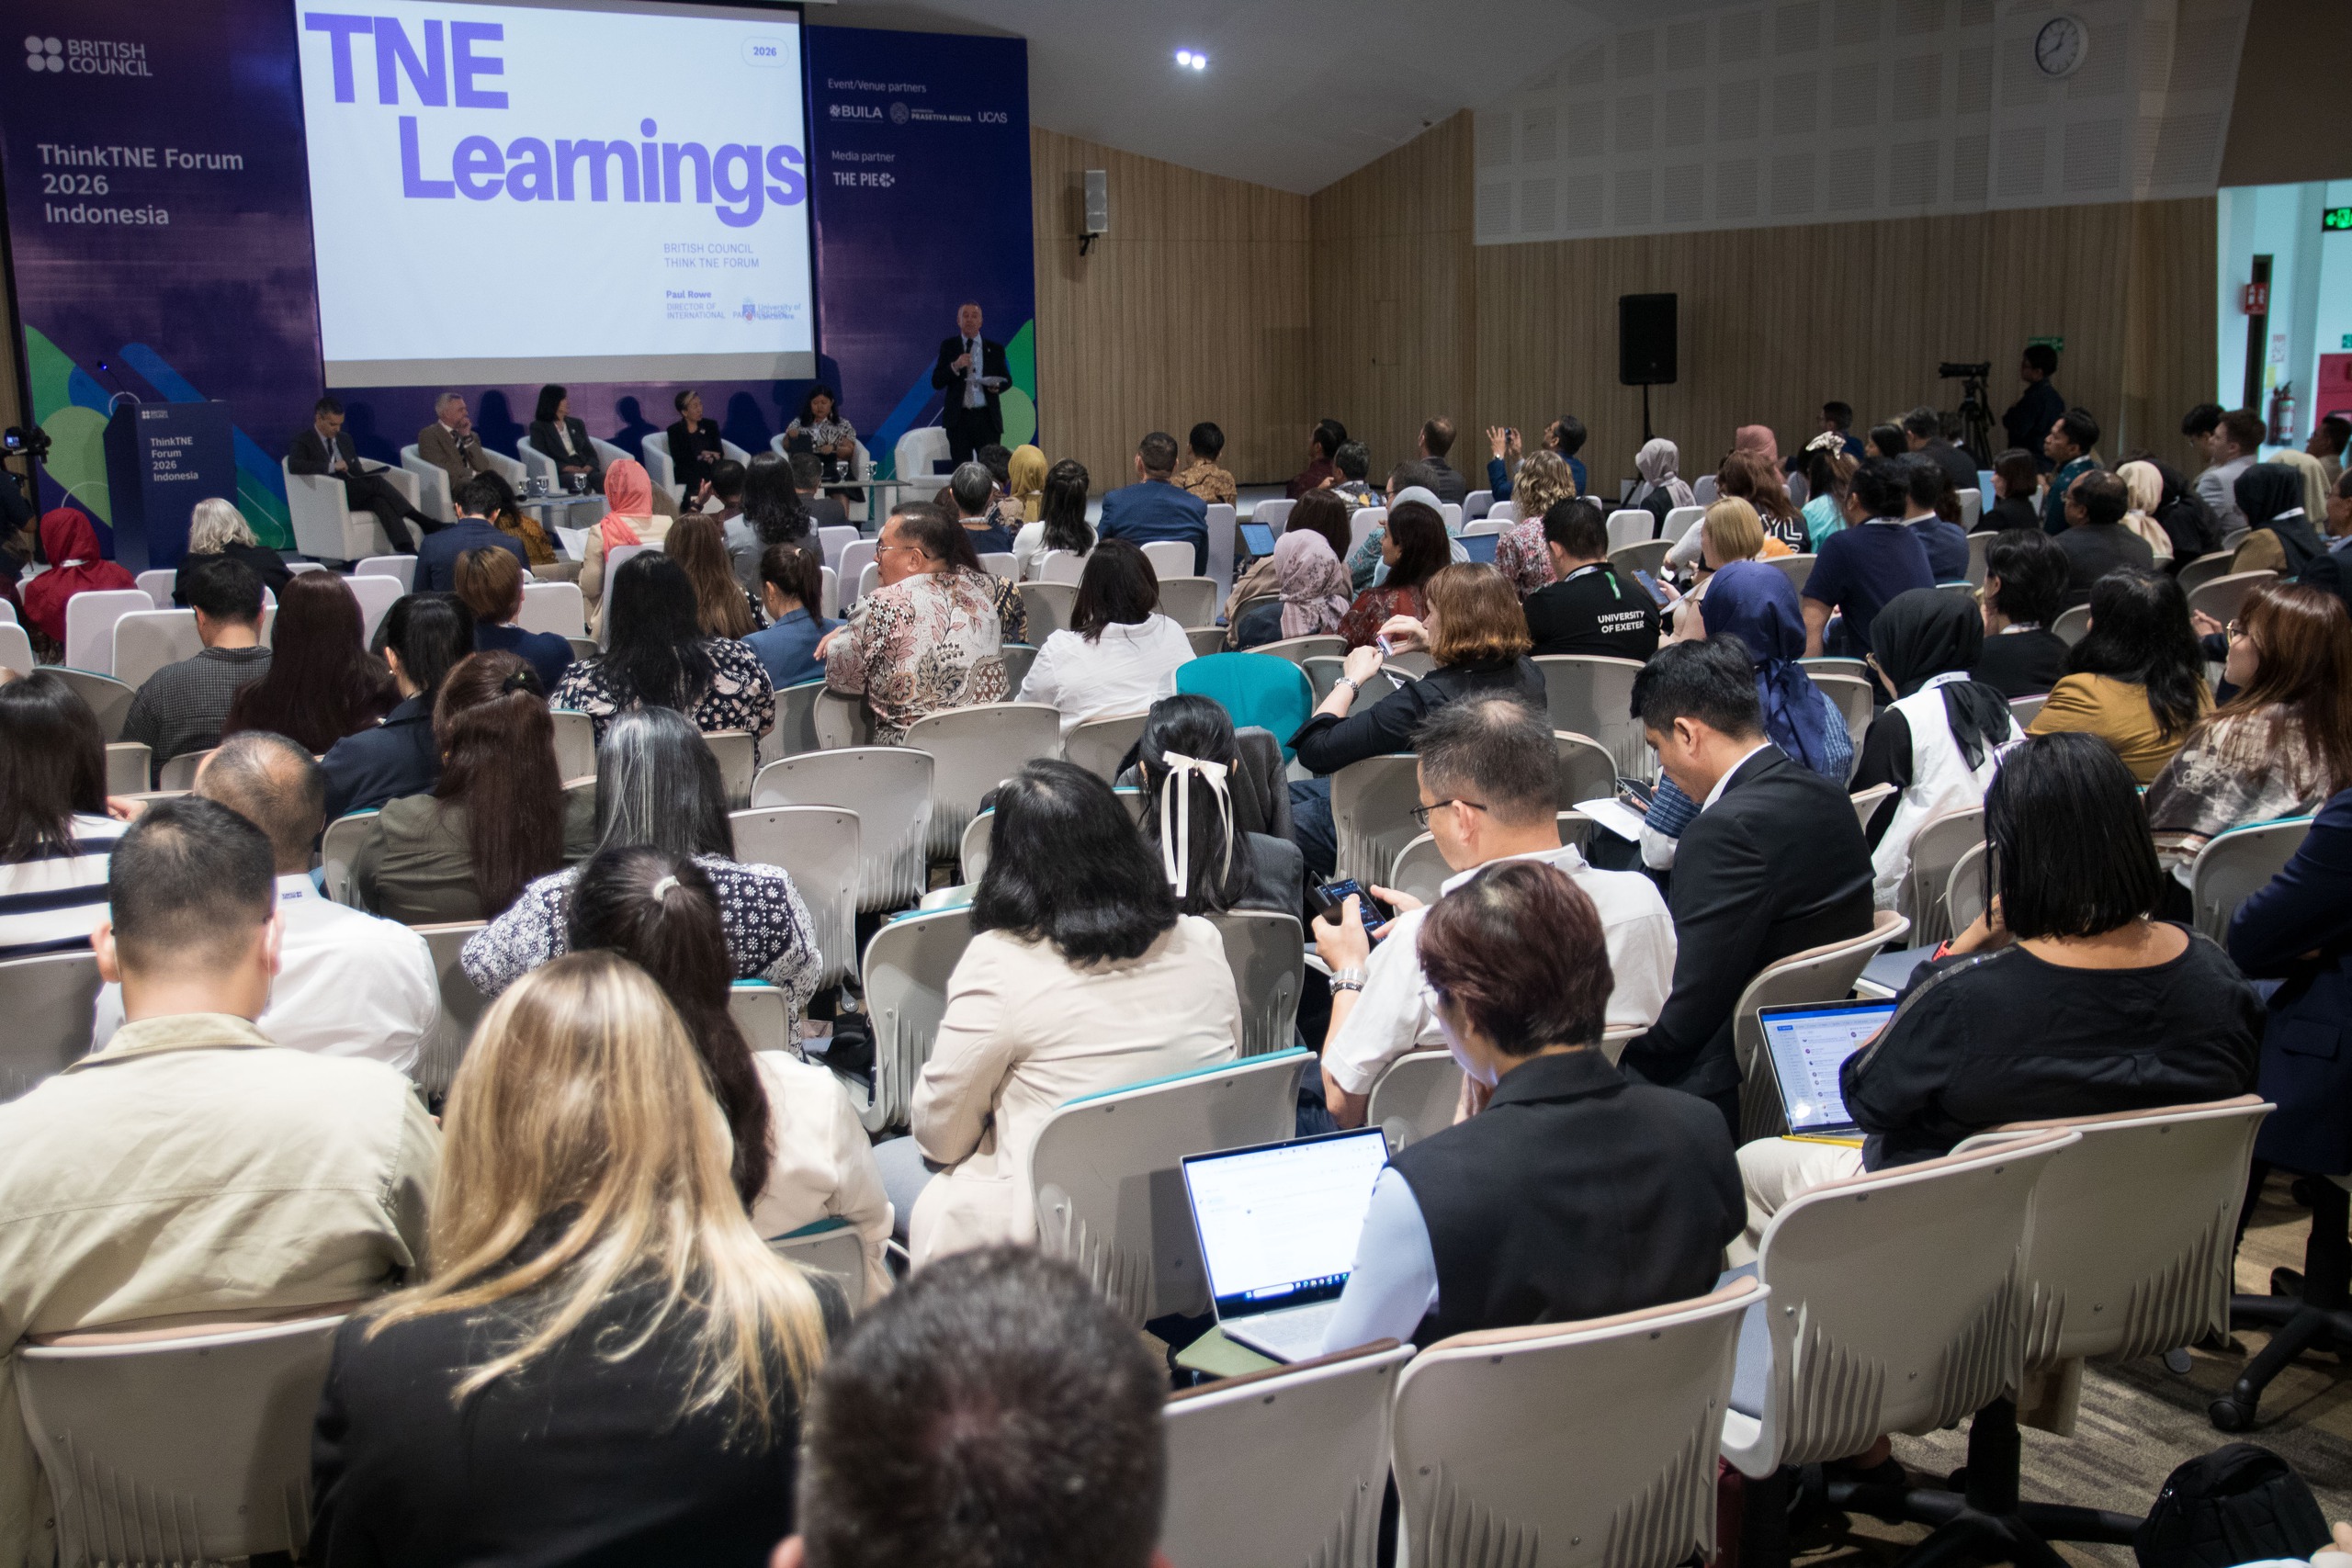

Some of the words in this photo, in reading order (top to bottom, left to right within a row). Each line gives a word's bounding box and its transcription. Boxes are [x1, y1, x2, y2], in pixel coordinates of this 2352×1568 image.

[67, 39, 146, 59] BRITISH
[752, 46, 777, 58] 2026
[69, 57, 153, 76] COUNCIL
[304, 12, 509, 109] TNE
[828, 78, 886, 91] Event/Venue
[888, 84, 927, 93] partners
[842, 105, 883, 118] BUILA
[978, 111, 1008, 123] UCAS
[37, 144, 157, 168] ThinkTNE
[165, 149, 243, 170] Forum
[831, 151, 859, 161] Media
[862, 152, 895, 163] partner
[399, 116, 807, 228] Learnings
[41, 174, 109, 195] 2026
[833, 172, 856, 186] THE
[860, 173, 878, 186] PIE
[46, 203, 169, 224] Indonesia
[664, 243, 704, 254] BRITISH
[708, 243, 753, 254] COUNCIL
[664, 258, 695, 268] THINK
[699, 258, 719, 268] TNE
[724, 258, 759, 268] FORUM
[666, 290, 685, 299] Paul
[688, 290, 711, 299] Rowe
[151, 436, 193, 446] ThinkTNE
[152, 449, 182, 458] Forum
[153, 460, 177, 470] 2026
[153, 471, 198, 481] Indonesia
[1598, 611, 1645, 624] UNIVERSITY
[1601, 624, 1614, 634] OF
[1615, 621, 1645, 632] EXETER
